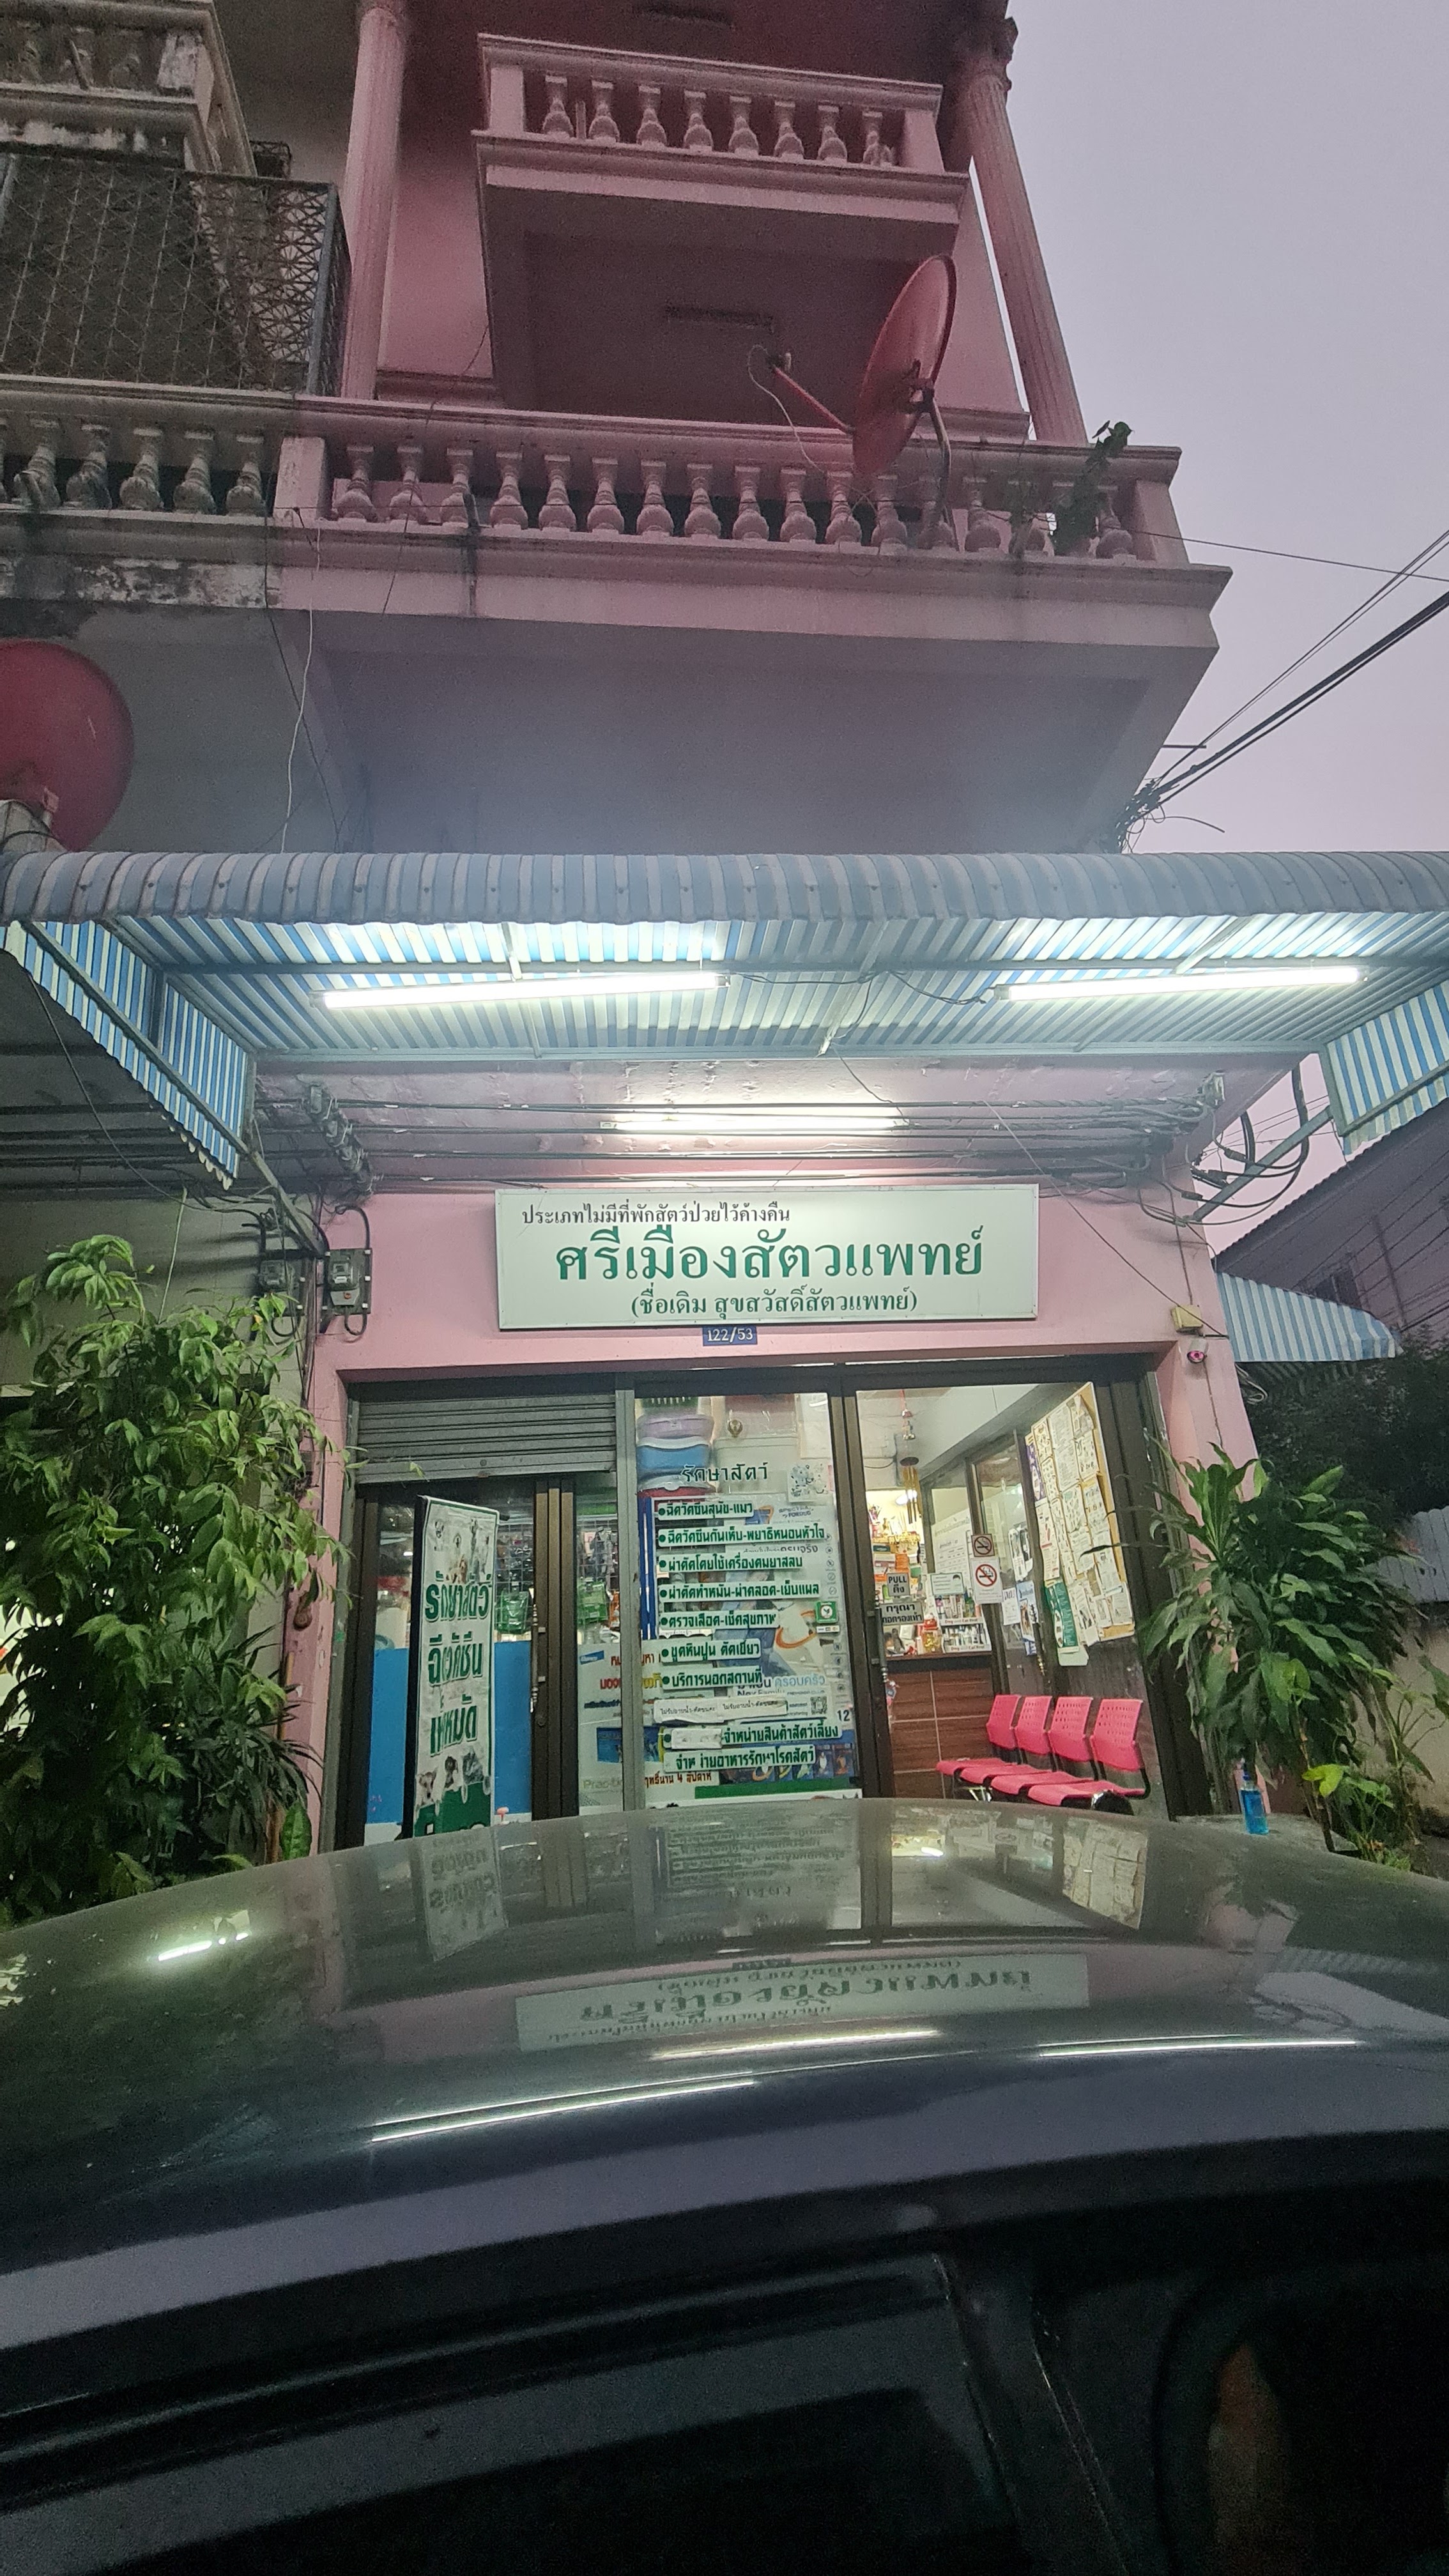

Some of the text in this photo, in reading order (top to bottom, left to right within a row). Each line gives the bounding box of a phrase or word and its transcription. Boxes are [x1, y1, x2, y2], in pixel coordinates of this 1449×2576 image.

[522, 1199, 790, 1224] ประเภทไม่มีที่พักสัตว์ป่วยไว้ค้างคืน
[556, 1223, 984, 1280] ศรีเมืองสัตวแพทย์
[631, 1283, 918, 1321] (ชื่อเดิม สุขสวัสดิ์สัตวแพทย์)
[707, 1327, 753, 1343] 122/53
[681, 1462, 769, 1482] รักษาสัตว์
[886, 1604, 915, 1614] กรุณา
[671, 1641, 716, 1661] ขูดหินปูน
[837, 1710, 850, 1722] 12
